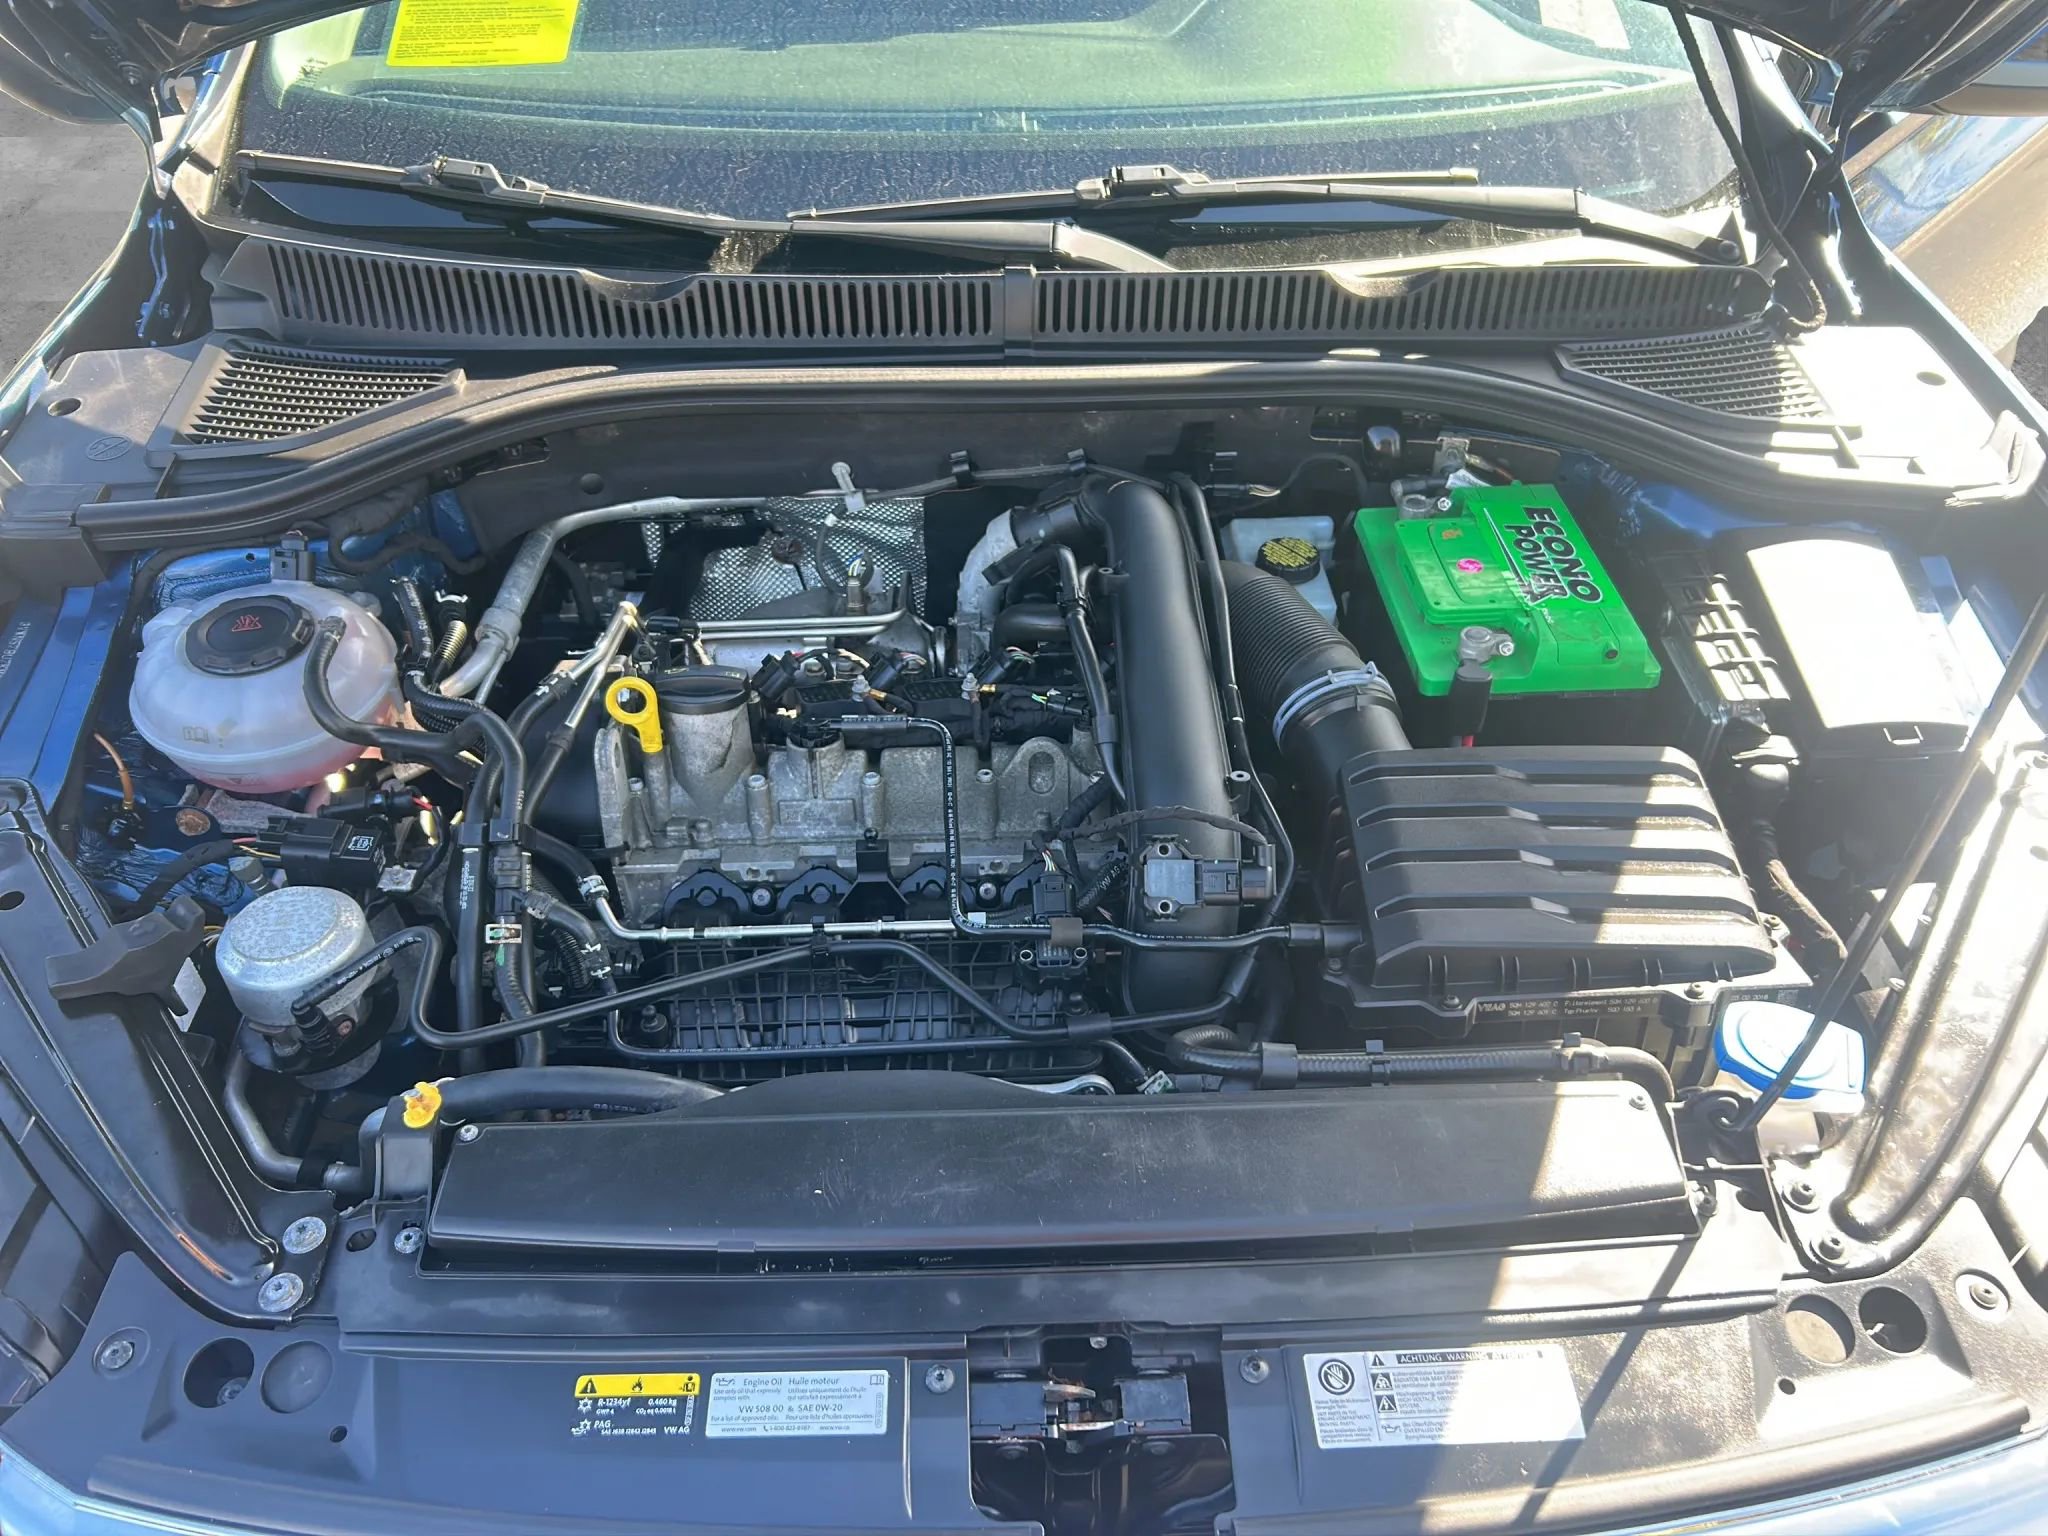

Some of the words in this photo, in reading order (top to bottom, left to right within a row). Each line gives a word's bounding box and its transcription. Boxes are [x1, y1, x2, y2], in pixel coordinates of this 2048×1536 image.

[1520, 505, 1604, 604] ECONO
[1503, 523, 1570, 606] POWER
[1400, 1353, 1442, 1363] ACHTUNG
[743, 1377, 770, 1388] Engine
[771, 1377, 783, 1386] Oil
[788, 1376, 809, 1386] Huile
[810, 1376, 839, 1385] moteur
[739, 1405, 754, 1413] VW
[755, 1405, 771, 1413] 508
[772, 1404, 784, 1412] 00
[798, 1403, 814, 1411] SAE
[815, 1403, 843, 1411] 0W-20
[593, 1420, 611, 1428] PAG
[664, 1426, 678, 1434] VW
[678, 1425, 690, 1434] AG
